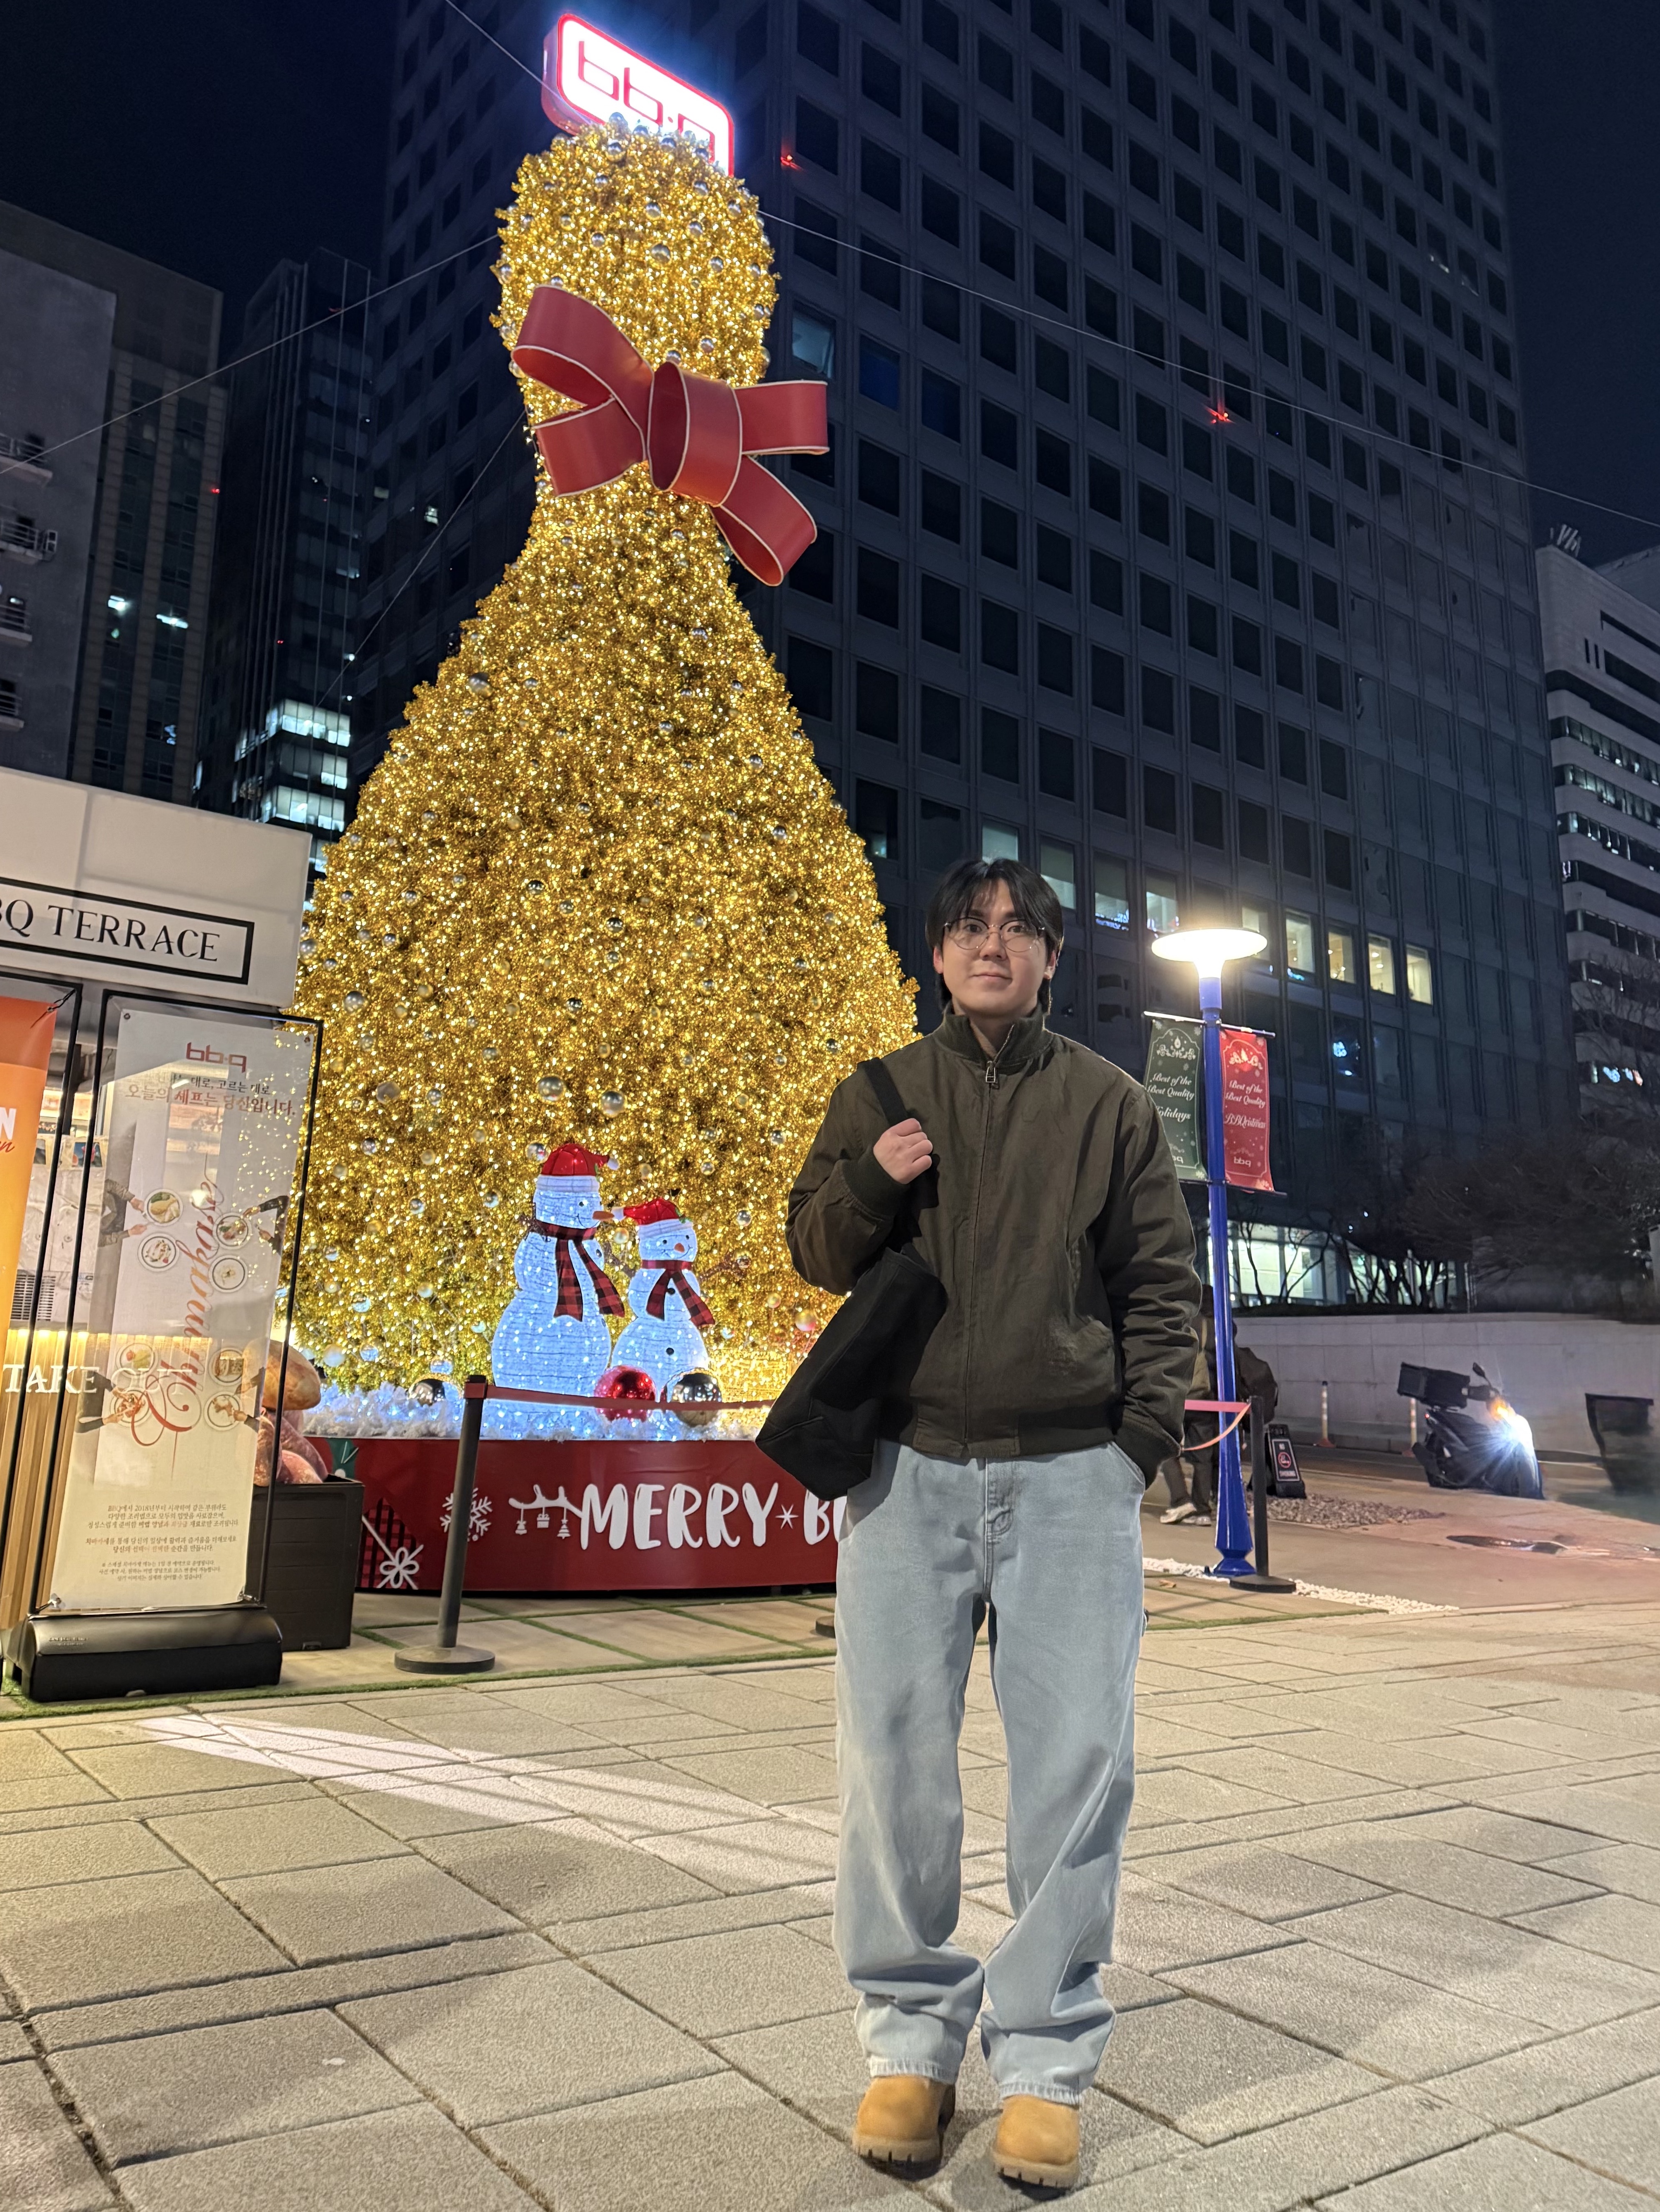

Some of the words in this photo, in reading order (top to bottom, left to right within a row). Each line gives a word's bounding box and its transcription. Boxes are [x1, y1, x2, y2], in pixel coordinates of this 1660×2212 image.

[0, 898, 34, 937] Q
[48, 905, 220, 962] TERRACE
[217, 1079, 247, 1093] 고르는
[1153, 1073, 1171, 1083] Best
[1171, 1075, 1182, 1087] of
[1181, 1076, 1192, 1085] the
[1229, 1080, 1246, 1090] Best
[1246, 1084, 1255, 1094] of
[125, 1084, 170, 1103] 오늘의
[1167, 1087, 1195, 1101] Quality
[1225, 1092, 1242, 1102] Best
[1243, 1095, 1265, 1108] Quality
[1234, 1156, 1251, 1167] bbq
[2, 1364, 100, 1394] TAKE
[581, 1482, 778, 1551] MERRY
